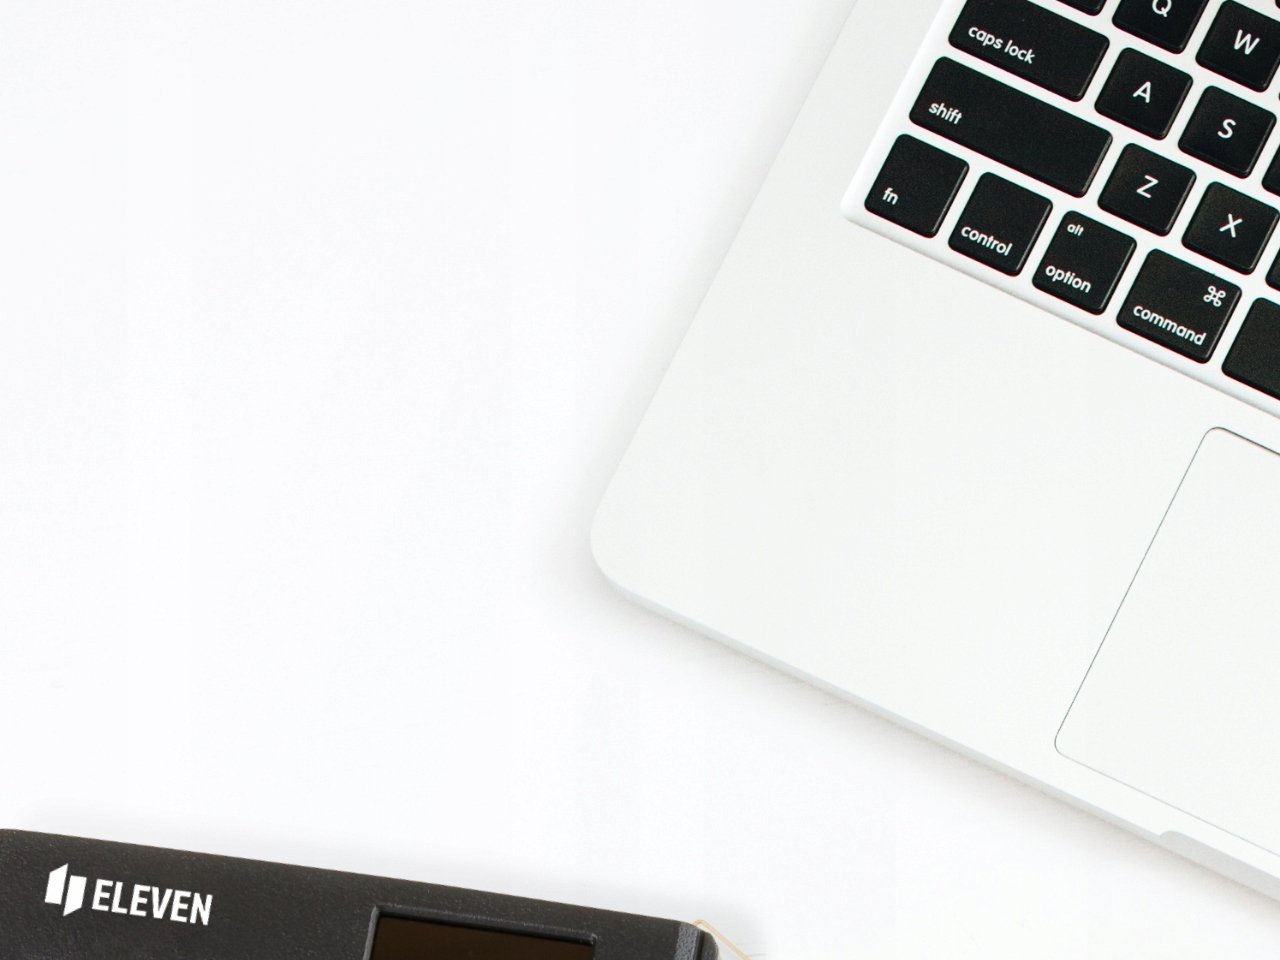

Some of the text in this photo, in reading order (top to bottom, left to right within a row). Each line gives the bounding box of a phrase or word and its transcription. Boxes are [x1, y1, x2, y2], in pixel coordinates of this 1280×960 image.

[1151, 0, 1172, 18] Q
[968, 26, 1035, 64] caps lock
[1233, 29, 1260, 55] W
[1132, 81, 1152, 104] A
[928, 102, 962, 125] shift
[1217, 118, 1236, 139] S
[882, 187, 899, 205] fn
[1136, 174, 1159, 199] Z
[1067, 223, 1084, 236] alt
[1219, 213, 1243, 238] X
[961, 226, 1013, 257] control
[1045, 265, 1092, 293] option
[1133, 305, 1206, 346] command
[91, 878, 213, 926] ELEVEN
